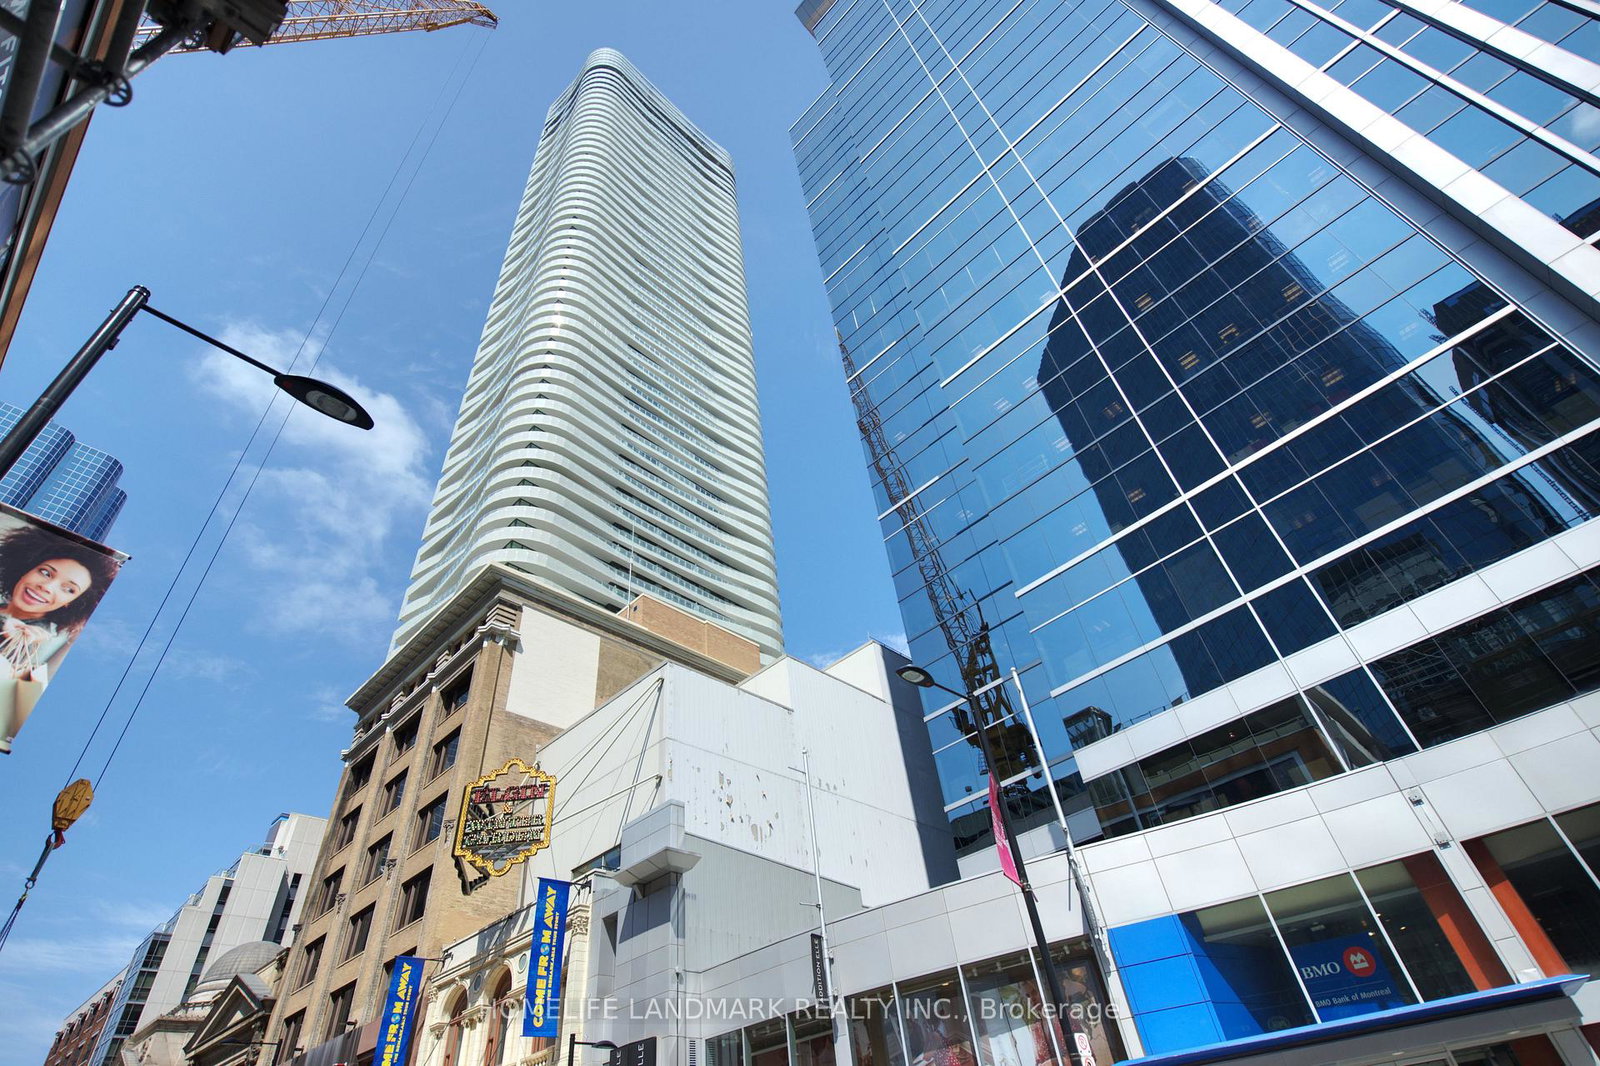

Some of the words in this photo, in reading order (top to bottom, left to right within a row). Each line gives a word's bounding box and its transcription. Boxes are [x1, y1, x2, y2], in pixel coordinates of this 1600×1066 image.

[473, 784, 547, 803] ELGIN
[544, 886, 557, 929] AWAY
[538, 930, 552, 976] FROM
[1300, 961, 1341, 979] BMO
[397, 962, 412, 1000] AWAY
[1314, 999, 1331, 1008] BMO
[1332, 994, 1350, 1004] Bank
[1351, 992, 1360, 1001] of
[1360, 986, 1392, 998] Montreal
[533, 978, 546, 1027] COME
[386, 1002, 404, 1042] FROM
[381, 1044, 395, 1066] ME
